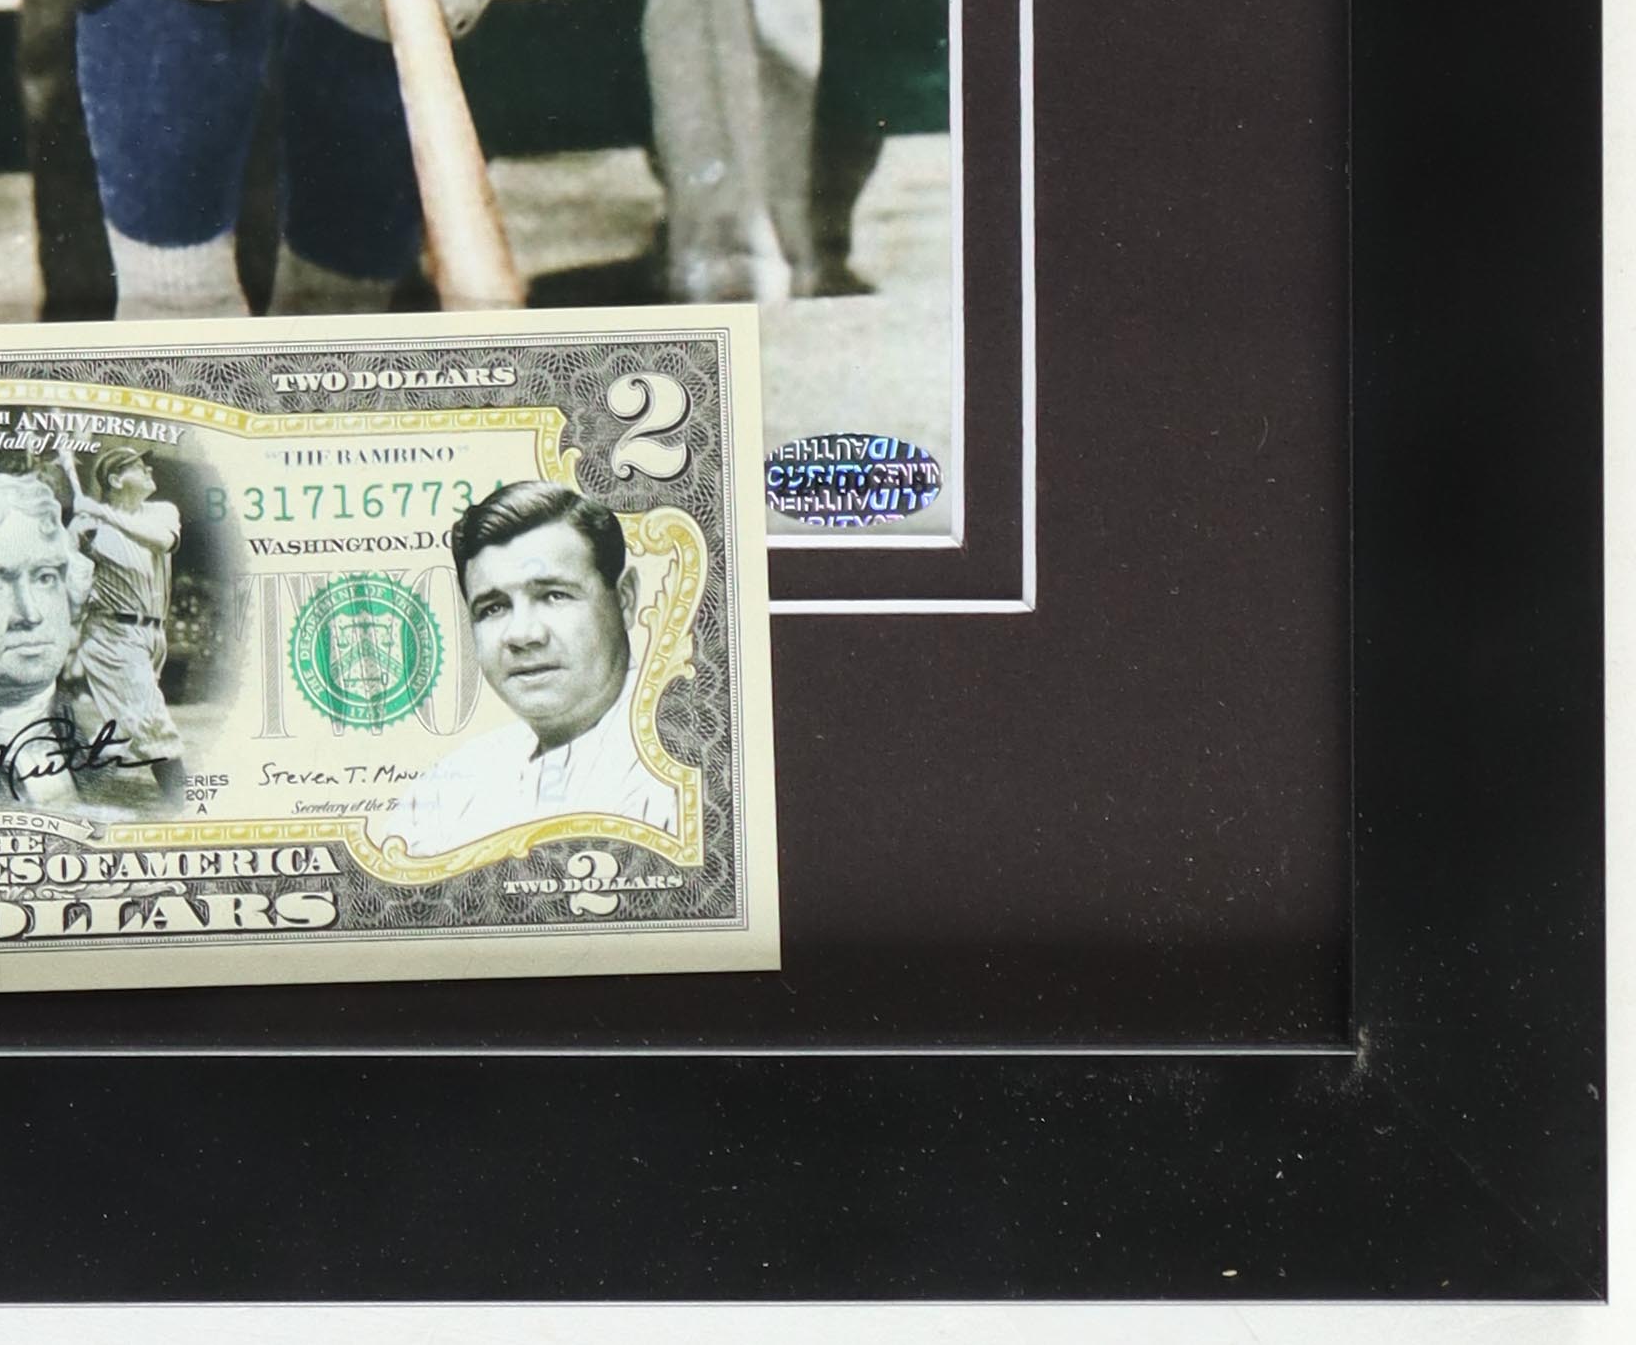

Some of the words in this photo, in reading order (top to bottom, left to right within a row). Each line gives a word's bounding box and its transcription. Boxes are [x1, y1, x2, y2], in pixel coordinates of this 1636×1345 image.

[271, 371, 349, 394] TWO
[351, 367, 517, 391] DOLLARS
[16, 411, 186, 446] ANNIVERSARY
[606, 371, 693, 483] 2
[28, 432, 54, 456] of
[52, 432, 102, 454] Fame
[184, 774, 229, 787] ERIES
[258, 762, 340, 786] Steven
[185, 788, 218, 801] 2017
[196, 802, 208, 815] A
[291, 799, 348, 818] Secretary
[364, 798, 385, 811] the
[46, 851, 116, 885] OF
[114, 846, 341, 882] AMERICA
[503, 878, 559, 895] TWO
[563, 873, 685, 893] DOLLARS
